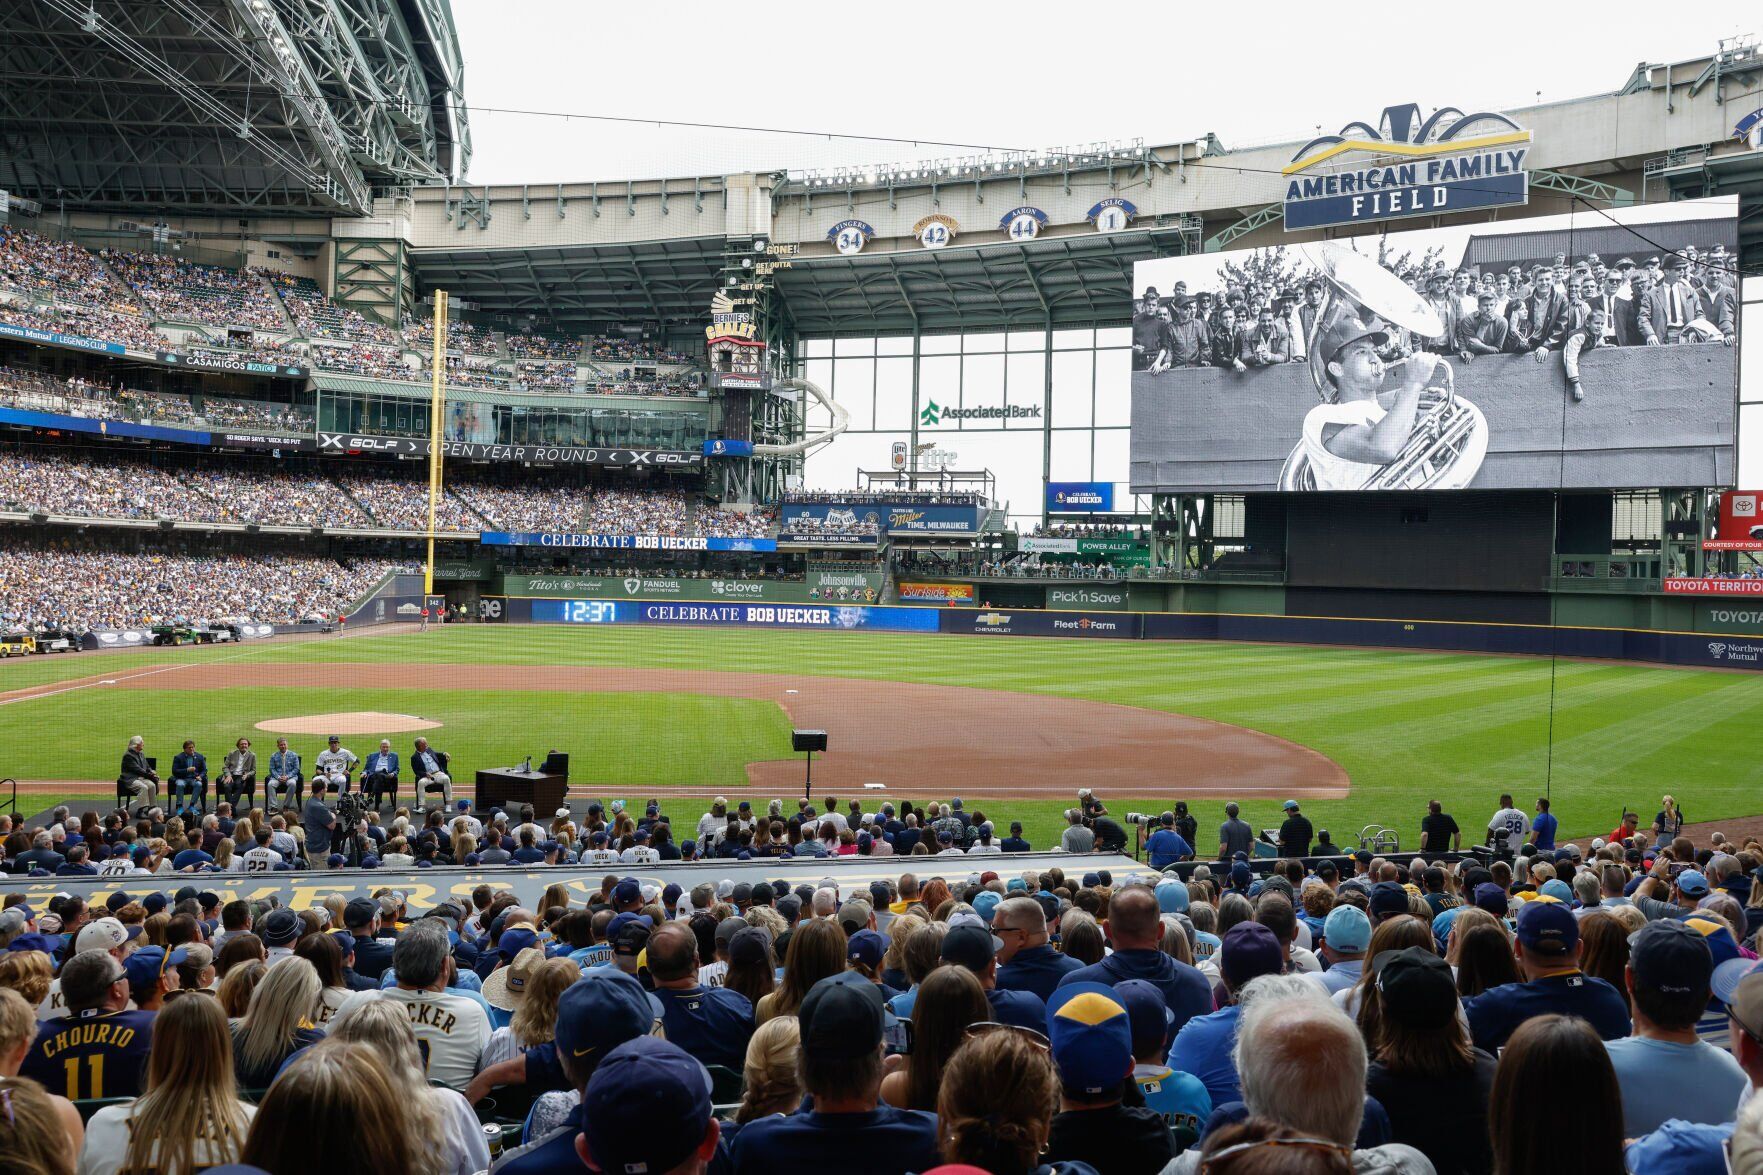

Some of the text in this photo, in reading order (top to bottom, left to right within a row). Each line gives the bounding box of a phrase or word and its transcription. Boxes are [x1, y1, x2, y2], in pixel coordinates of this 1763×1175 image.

[1286, 149, 1532, 201] AMERICAN FAMILY
[1100, 199, 1123, 207] SELIG
[1352, 187, 1447, 217] FIELD
[1012, 207, 1037, 217] AARON
[835, 220, 866, 231] FINGERS
[918, 214, 952, 228] ROBINSON
[1012, 219, 1034, 237] 44
[1108, 213, 1116, 229] 1
[840, 233, 861, 249] 34
[924, 227, 946, 243] 42
[767, 245, 797, 255] GONE!
[714, 314, 749, 323] BERNIE'S
[0, 325, 107, 351] estern Mutual LEGENDS CLUB
[705, 323, 757, 340] CHALET
[186, 356, 273, 372] CASAMIGOS PATIO
[941, 404, 1042, 419] Associated Bank
[349, 438, 398, 450] GOLF
[481, 445, 525, 459] YEAR
[534, 448, 598, 462] ROUND
[655, 454, 702, 464] GOLF
[888, 511, 927, 528] Miller
[907, 521, 969, 530] TIME, MILWAUKEE
[541, 533, 708, 550] CELEBRATE BOB UECKER
[433, 566, 482, 580] arrel Yard
[819, 573, 867, 587] Johnsonville
[528, 579, 559, 591] Tito's
[643, 580, 681, 588] FANDUEL
[725, 580, 763, 593] clover
[1666, 580, 1763, 592] TOYOTA TERRITO
[1052, 591, 1078, 602] Pick
[1090, 592, 1121, 603] Save
[564, 601, 615, 622] 12:37
[647, 606, 830, 624] CELEBRATE BOB UECKER
[1054, 620, 1116, 630] Fleet Farm
[1728, 643, 1763, 653] Northwe
[1728, 653, 1758, 661] Mutual
[1505, 820, 1522, 834] 28
[247, 860, 268, 871] 22
[42, 1023, 136, 1059] CHOURIO
[64, 1053, 104, 1102] 11
